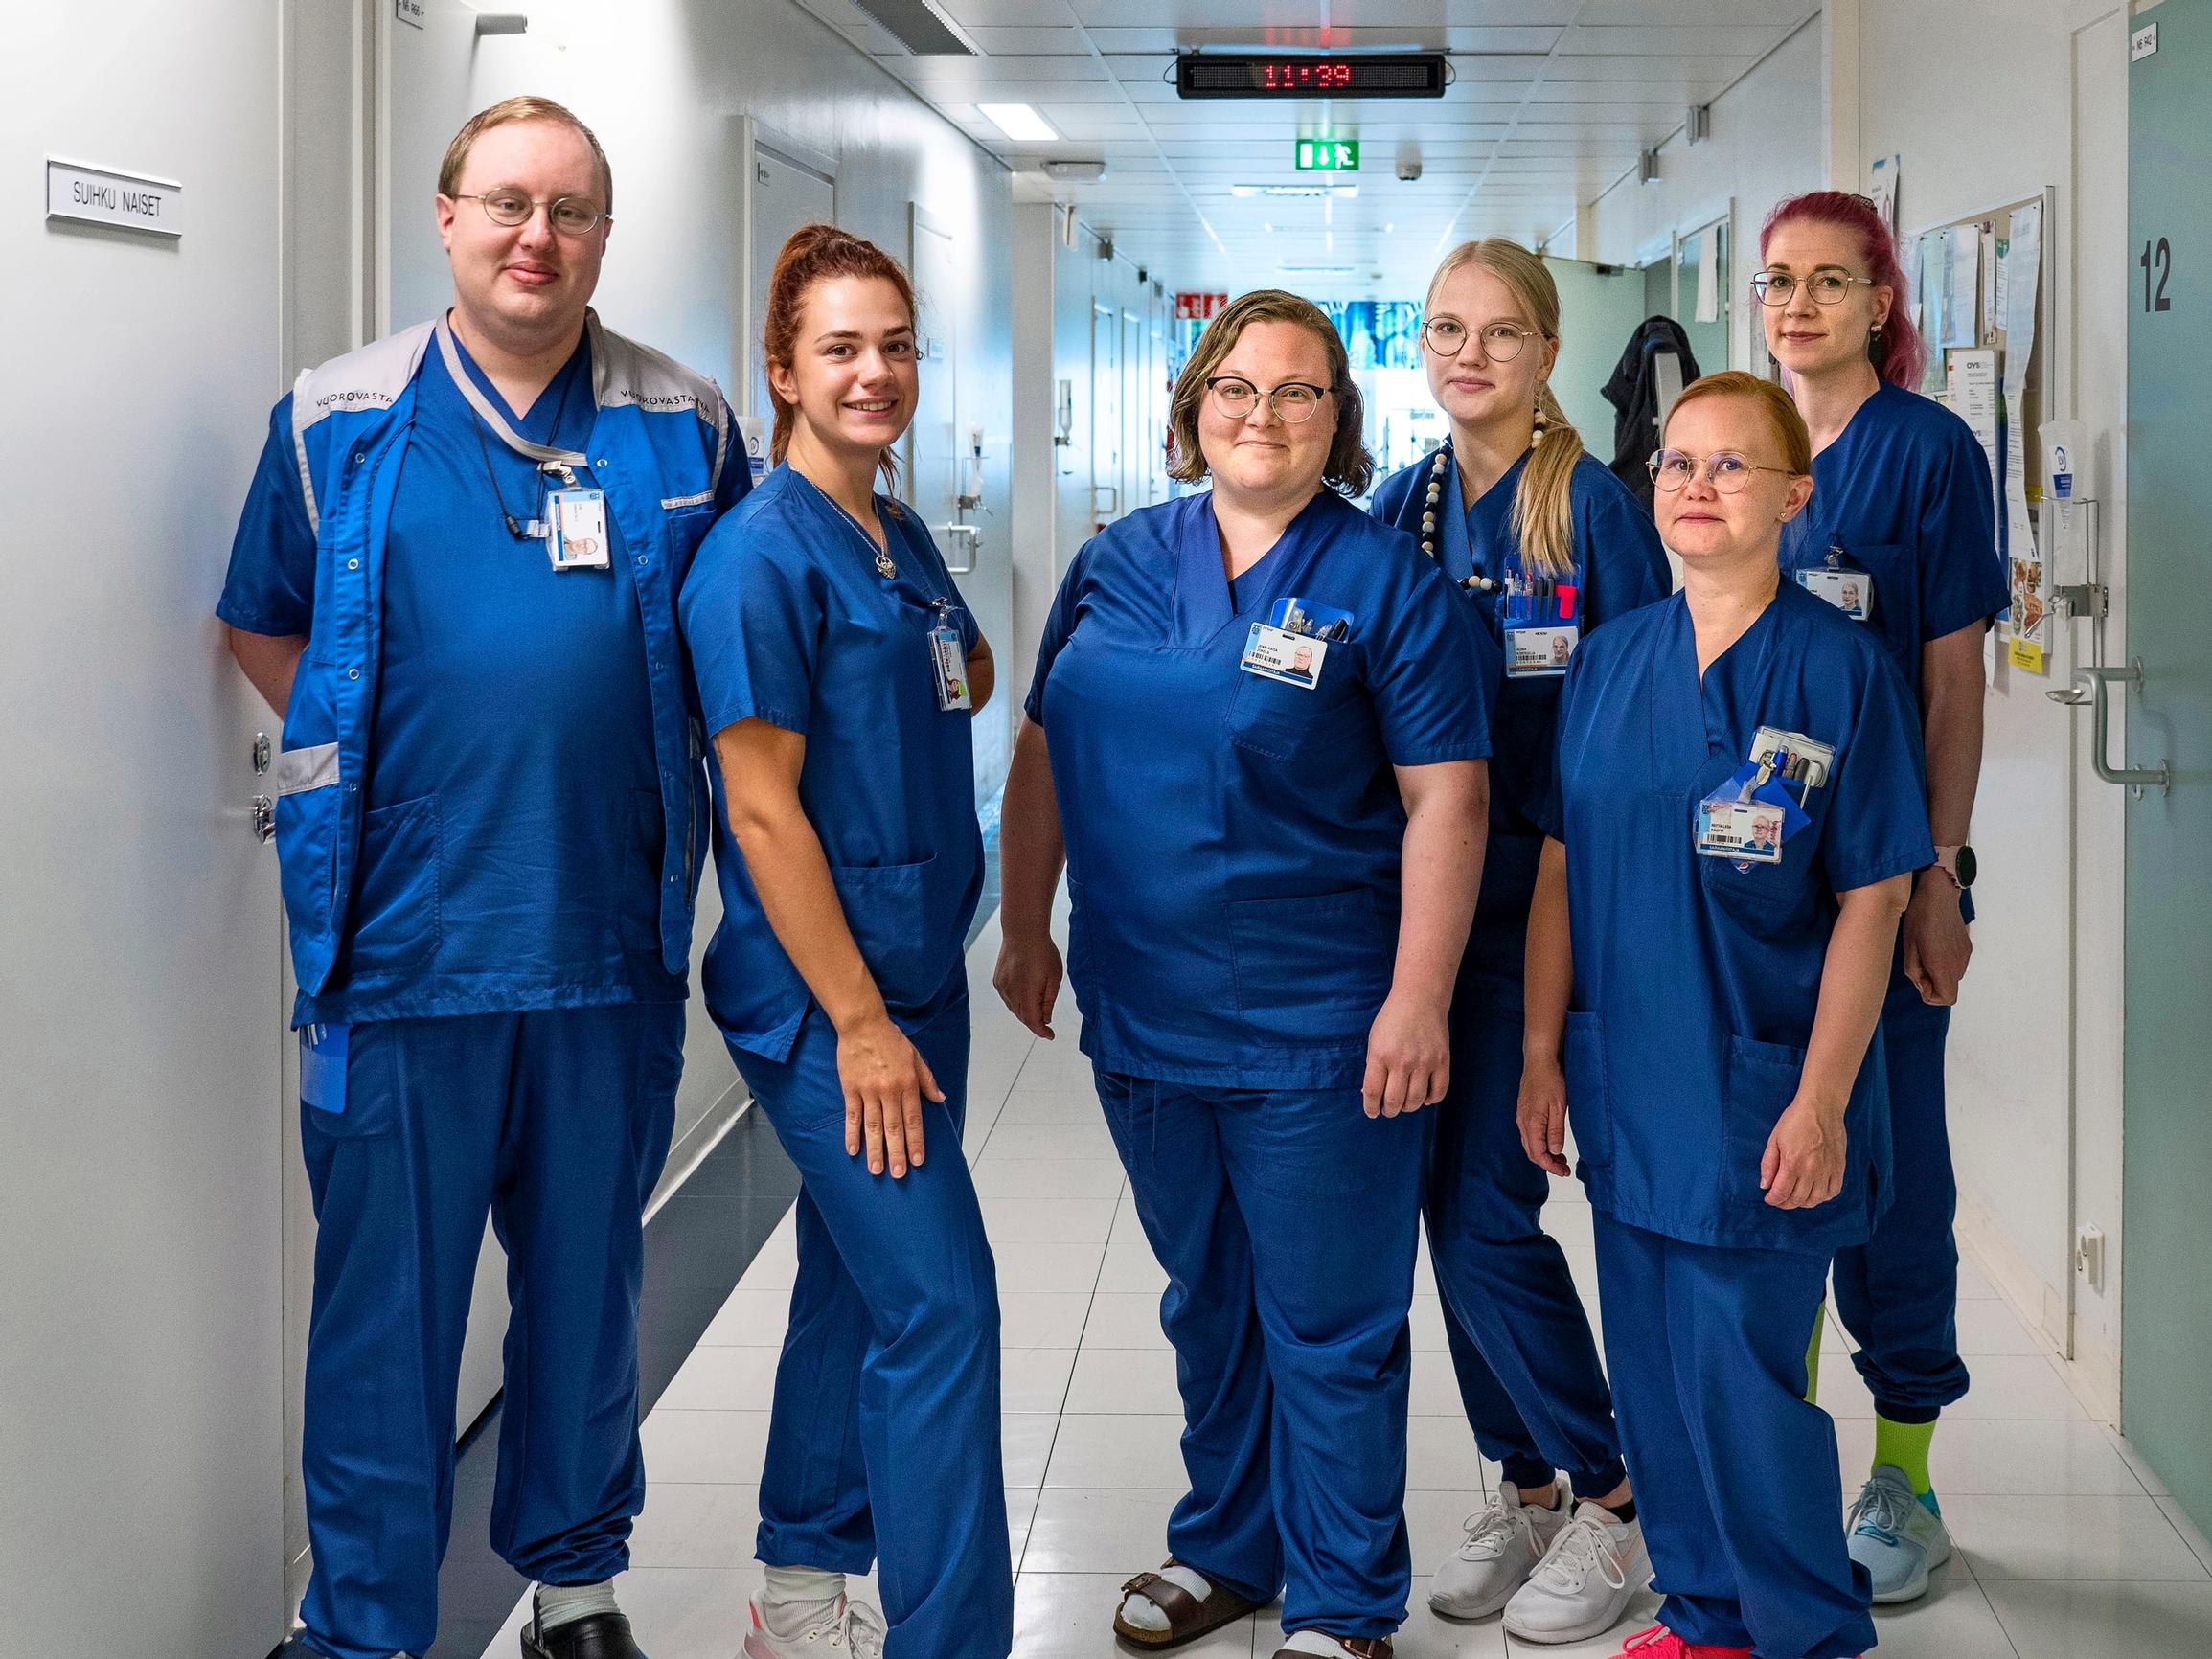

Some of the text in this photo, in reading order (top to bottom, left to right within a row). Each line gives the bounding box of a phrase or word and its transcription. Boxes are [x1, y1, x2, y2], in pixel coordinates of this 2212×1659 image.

[1266, 64, 1350, 87] 11:39
[74, 181, 162, 216] SUIHKU NAISET
[2140, 237, 2171, 312] 12
